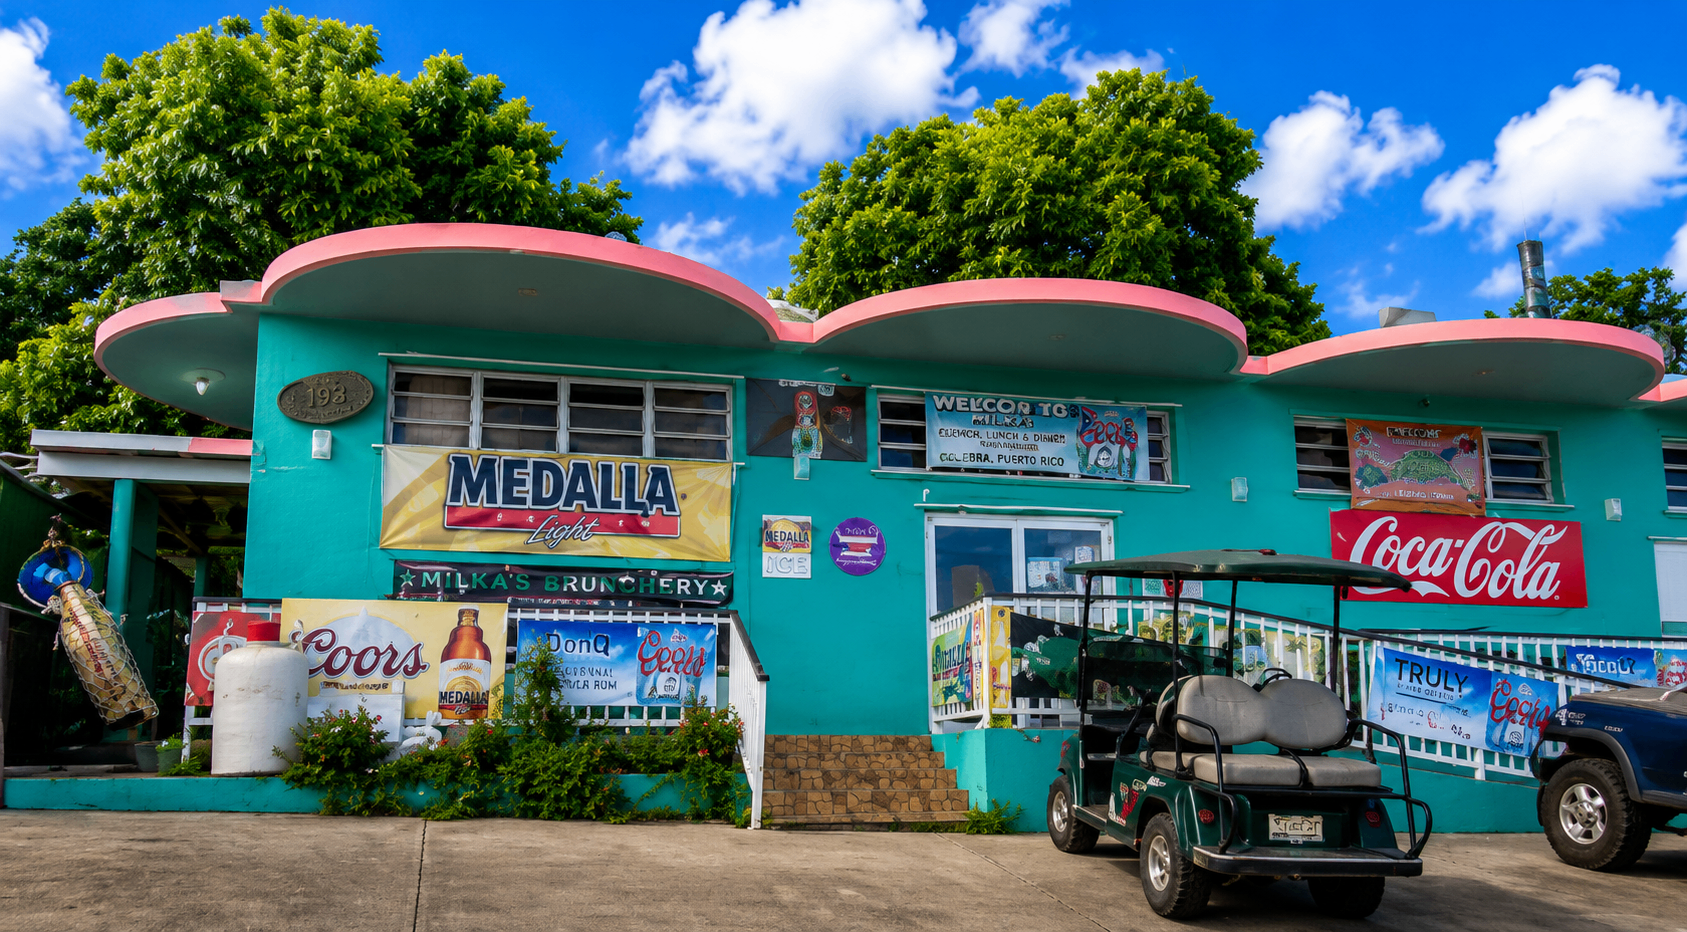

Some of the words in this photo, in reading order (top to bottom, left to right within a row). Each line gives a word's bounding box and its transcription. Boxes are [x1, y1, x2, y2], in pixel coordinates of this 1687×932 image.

[305, 383, 347, 407] 193
[986, 430, 1019, 441] LUNCH
[997, 454, 1037, 465] PUERTO
[1040, 456, 1065, 467] RICO
[446, 453, 681, 516] MEDALLA
[524, 514, 600, 549] Light
[765, 529, 811, 543] MEDALLA
[766, 555, 808, 575] ICE
[1349, 515, 1569, 601] Coca-Cola
[421, 571, 531, 592] MILKA'S
[544, 574, 708, 596] BRUNCHERY
[290, 627, 430, 680] Coors
[1395, 657, 1469, 696] TRULY
